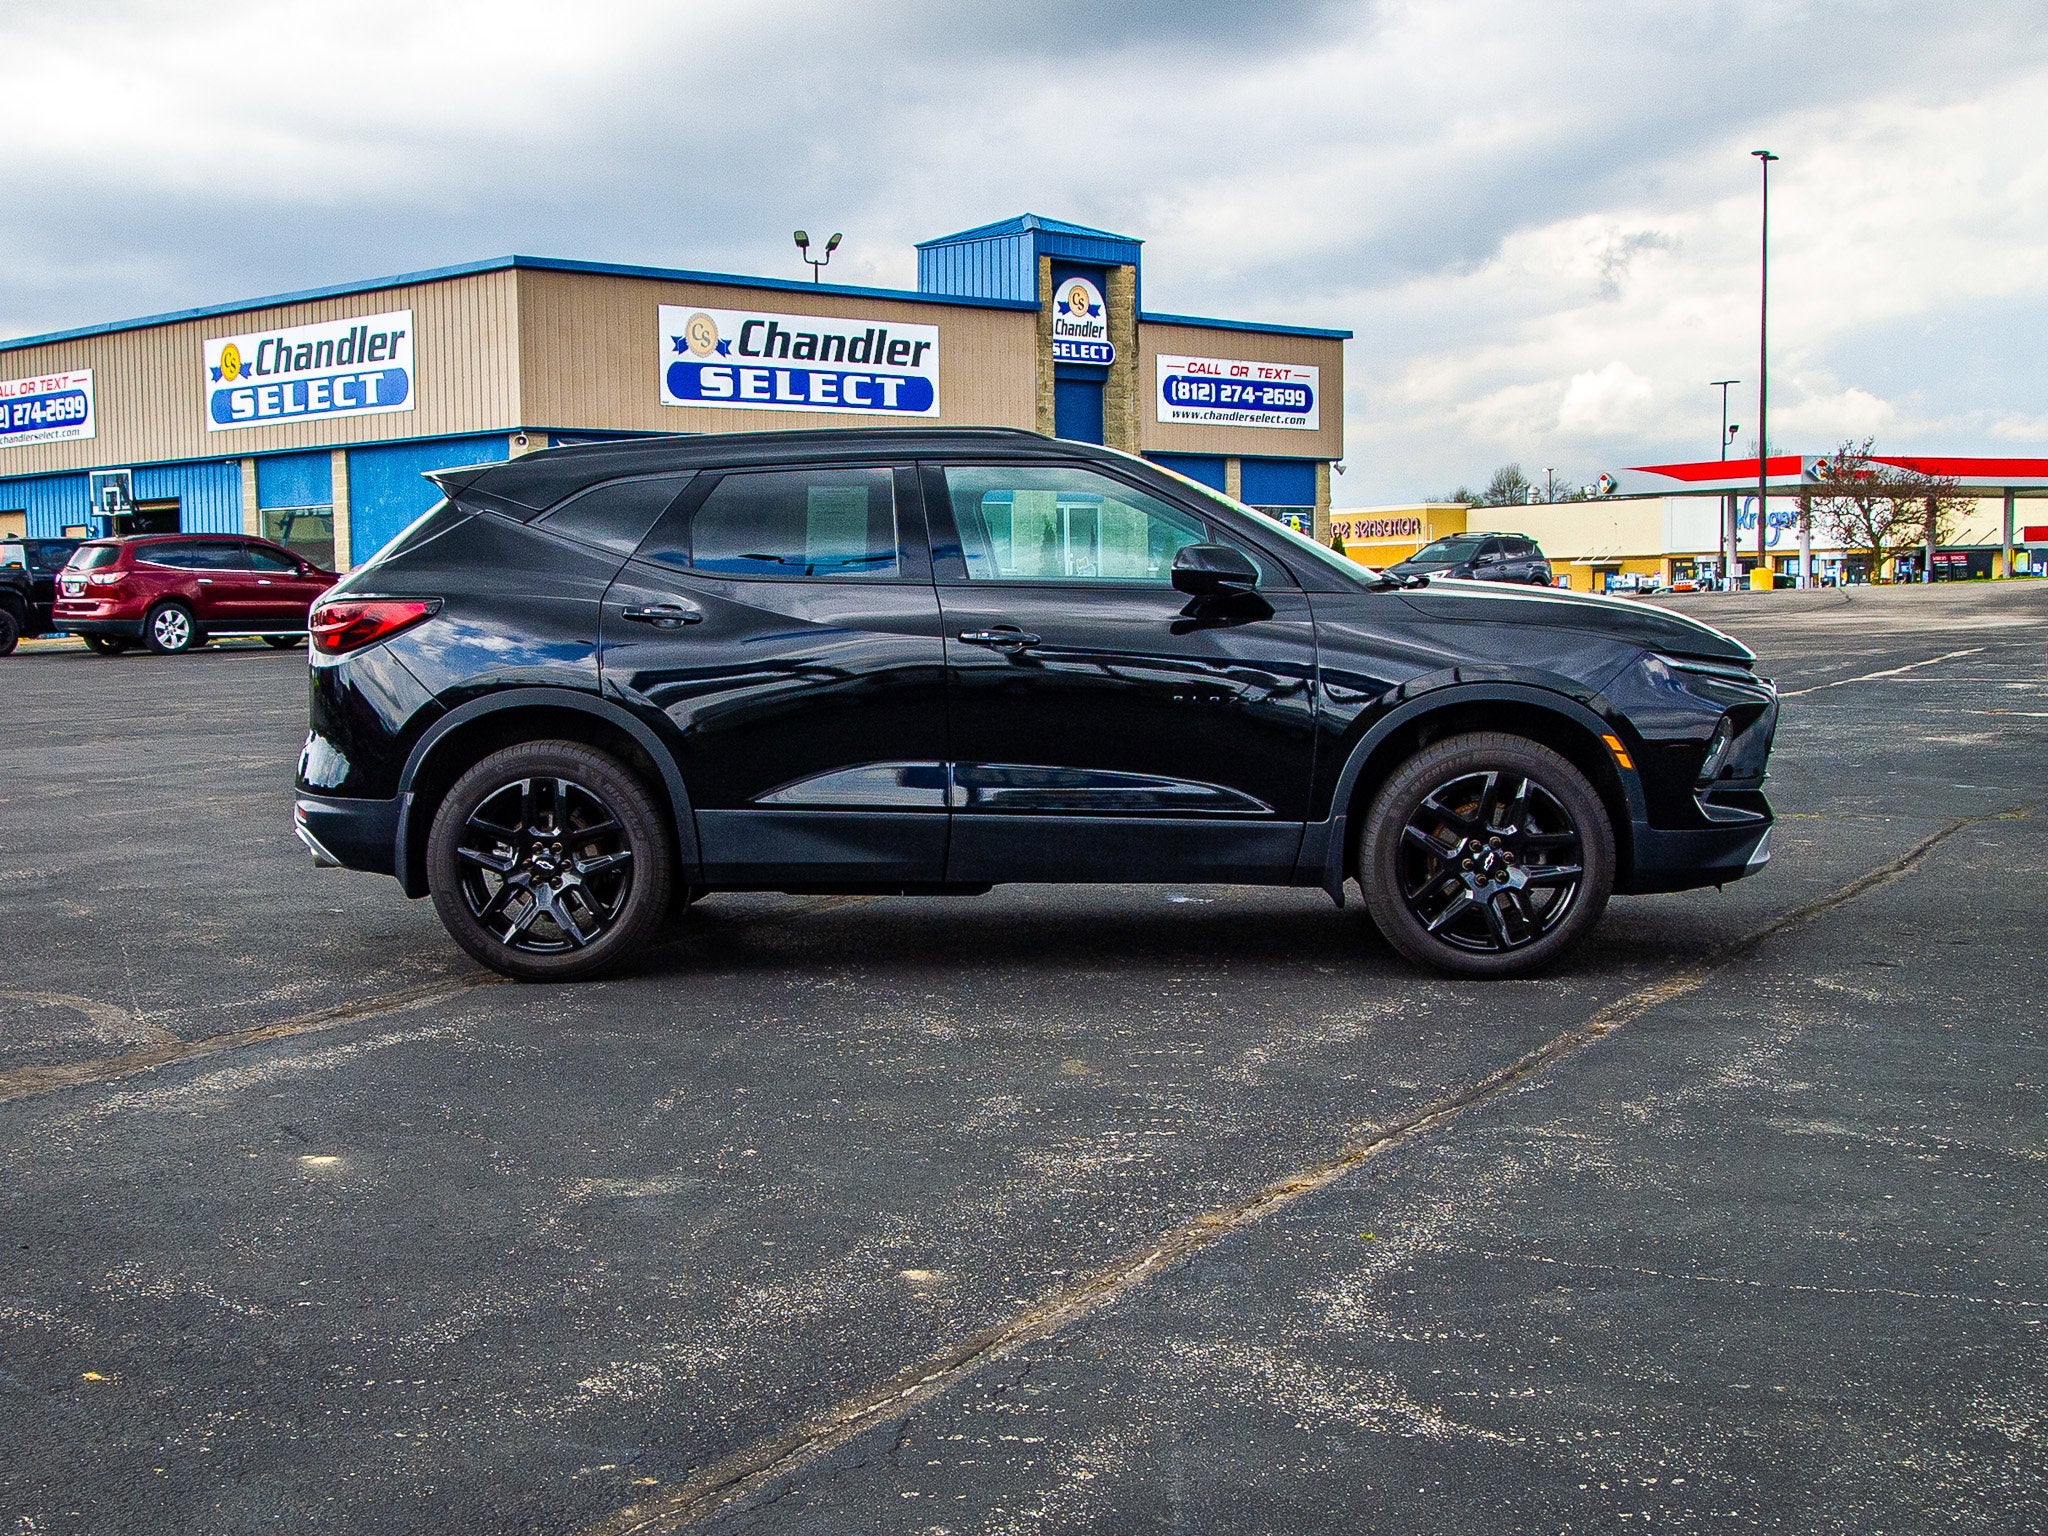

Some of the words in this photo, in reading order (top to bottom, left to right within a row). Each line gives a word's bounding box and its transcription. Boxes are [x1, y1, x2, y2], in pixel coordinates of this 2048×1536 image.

[1055, 318, 1104, 339] Chandler
[256, 325, 405, 376] Chandler
[738, 319, 931, 367] Chandler
[1053, 342, 1109, 360] SELECT
[1187, 362, 1221, 375] CALL
[1230, 365, 1249, 378] OR
[1258, 367, 1291, 380] TEXT
[20, 381, 36, 395] OR
[40, 376, 69, 392] TEXT
[230, 372, 384, 420] SELECT
[700, 366, 905, 407] SELECT
[1171, 380, 1216, 403] (812)
[1220, 384, 1306, 407] 274-2699
[13, 395, 86, 426] 274-2699
[1172, 409, 1306, 426] www.chandlerselect.com
